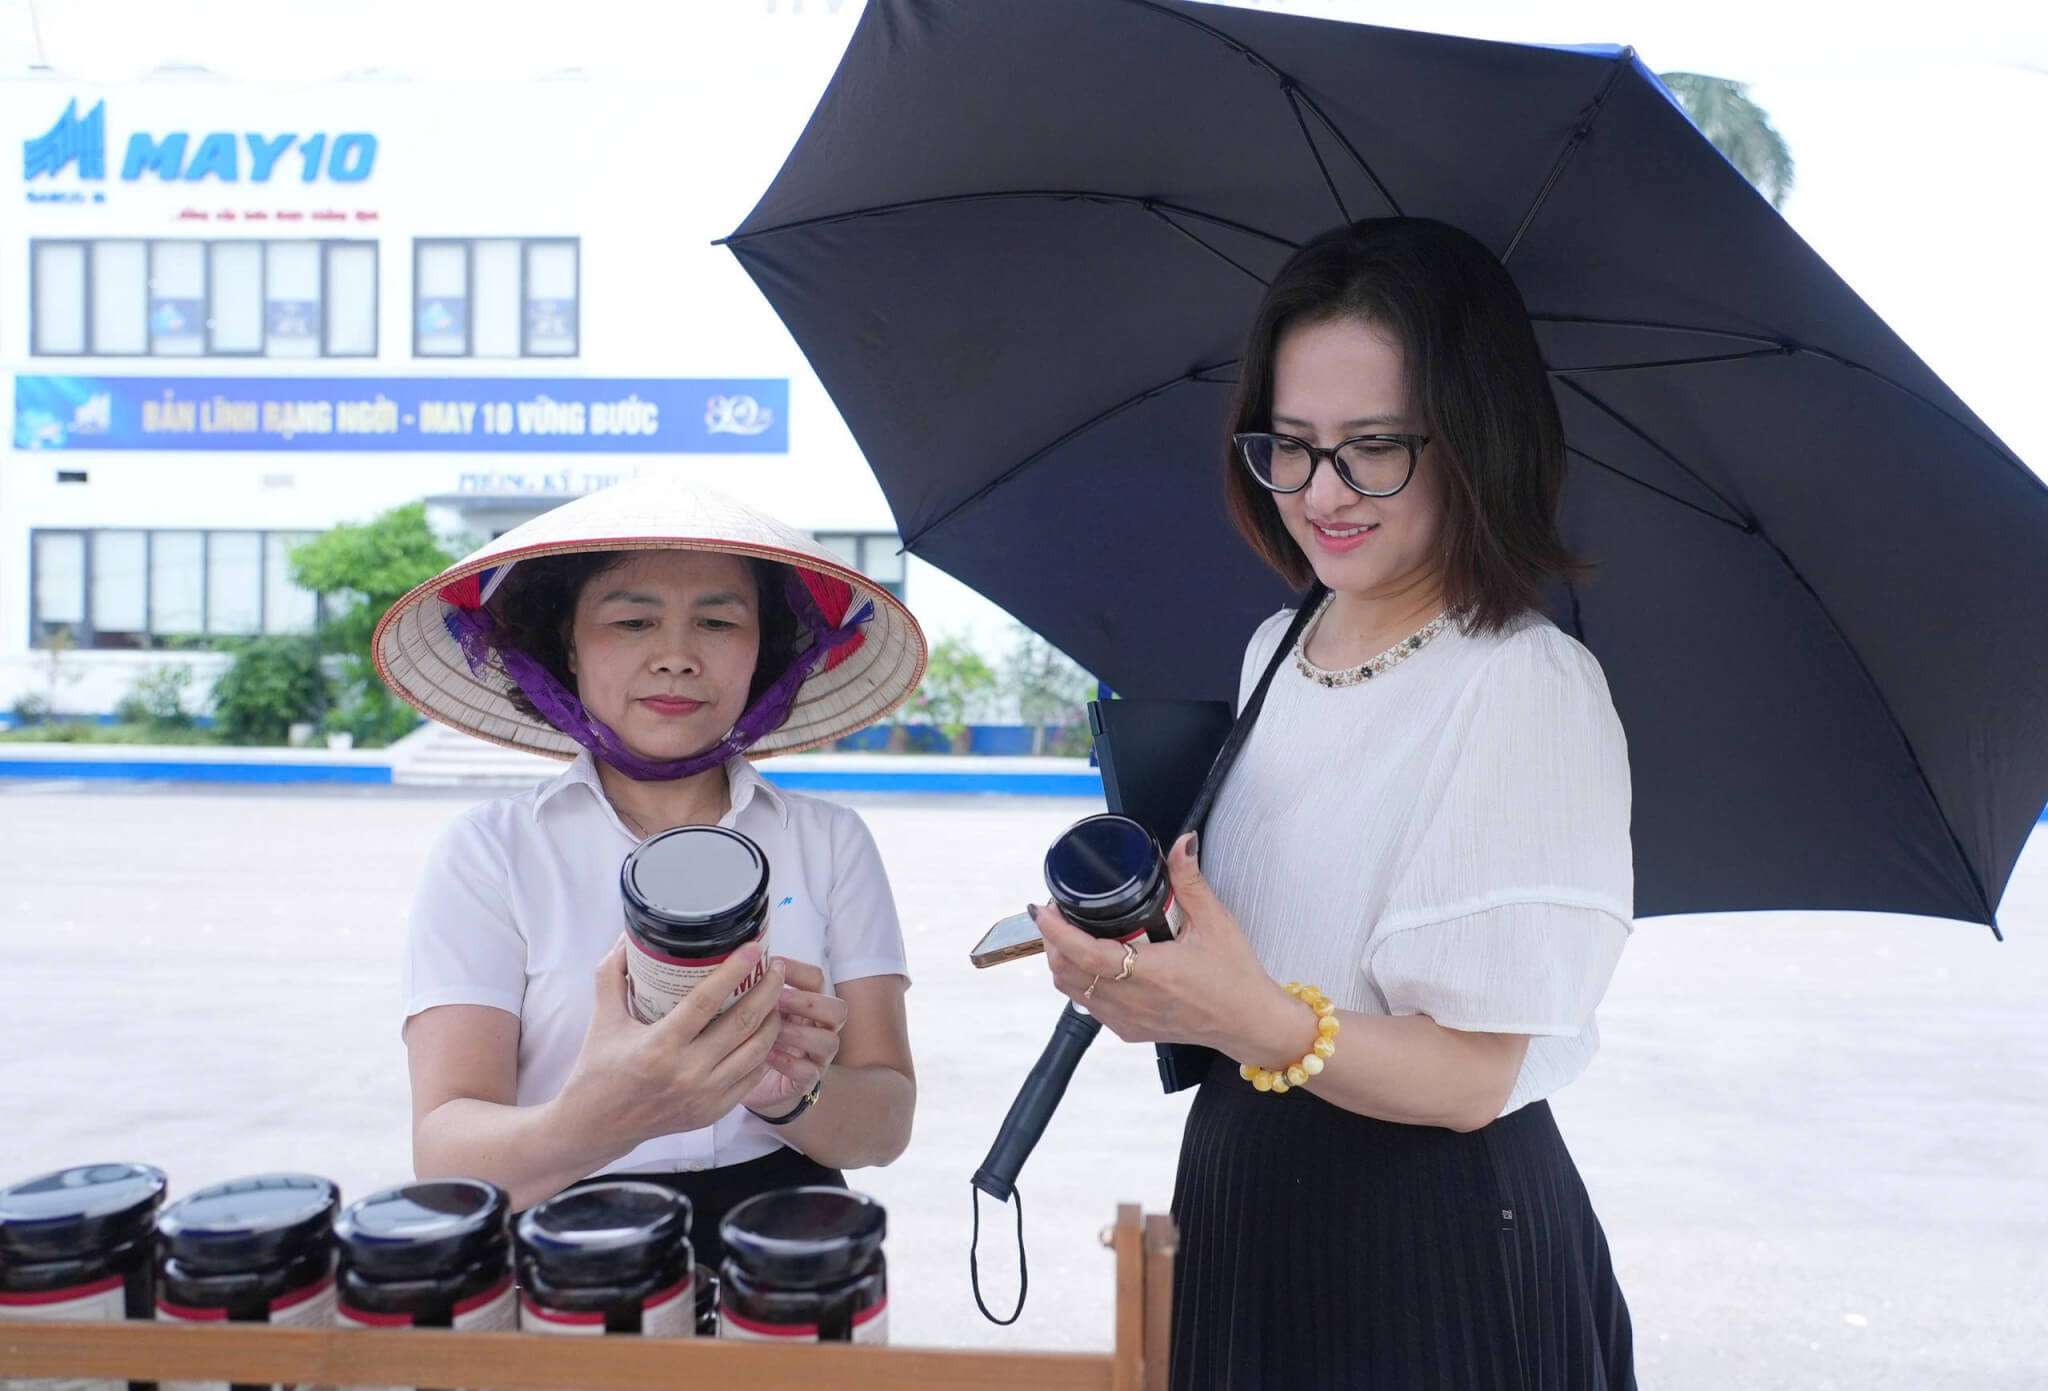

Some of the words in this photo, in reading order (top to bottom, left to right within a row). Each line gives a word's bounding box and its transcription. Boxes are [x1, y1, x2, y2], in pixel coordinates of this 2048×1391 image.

[142, 389, 197, 433] BẢN
[419, 401, 477, 434] MAY
[482, 401, 514, 434] 10
